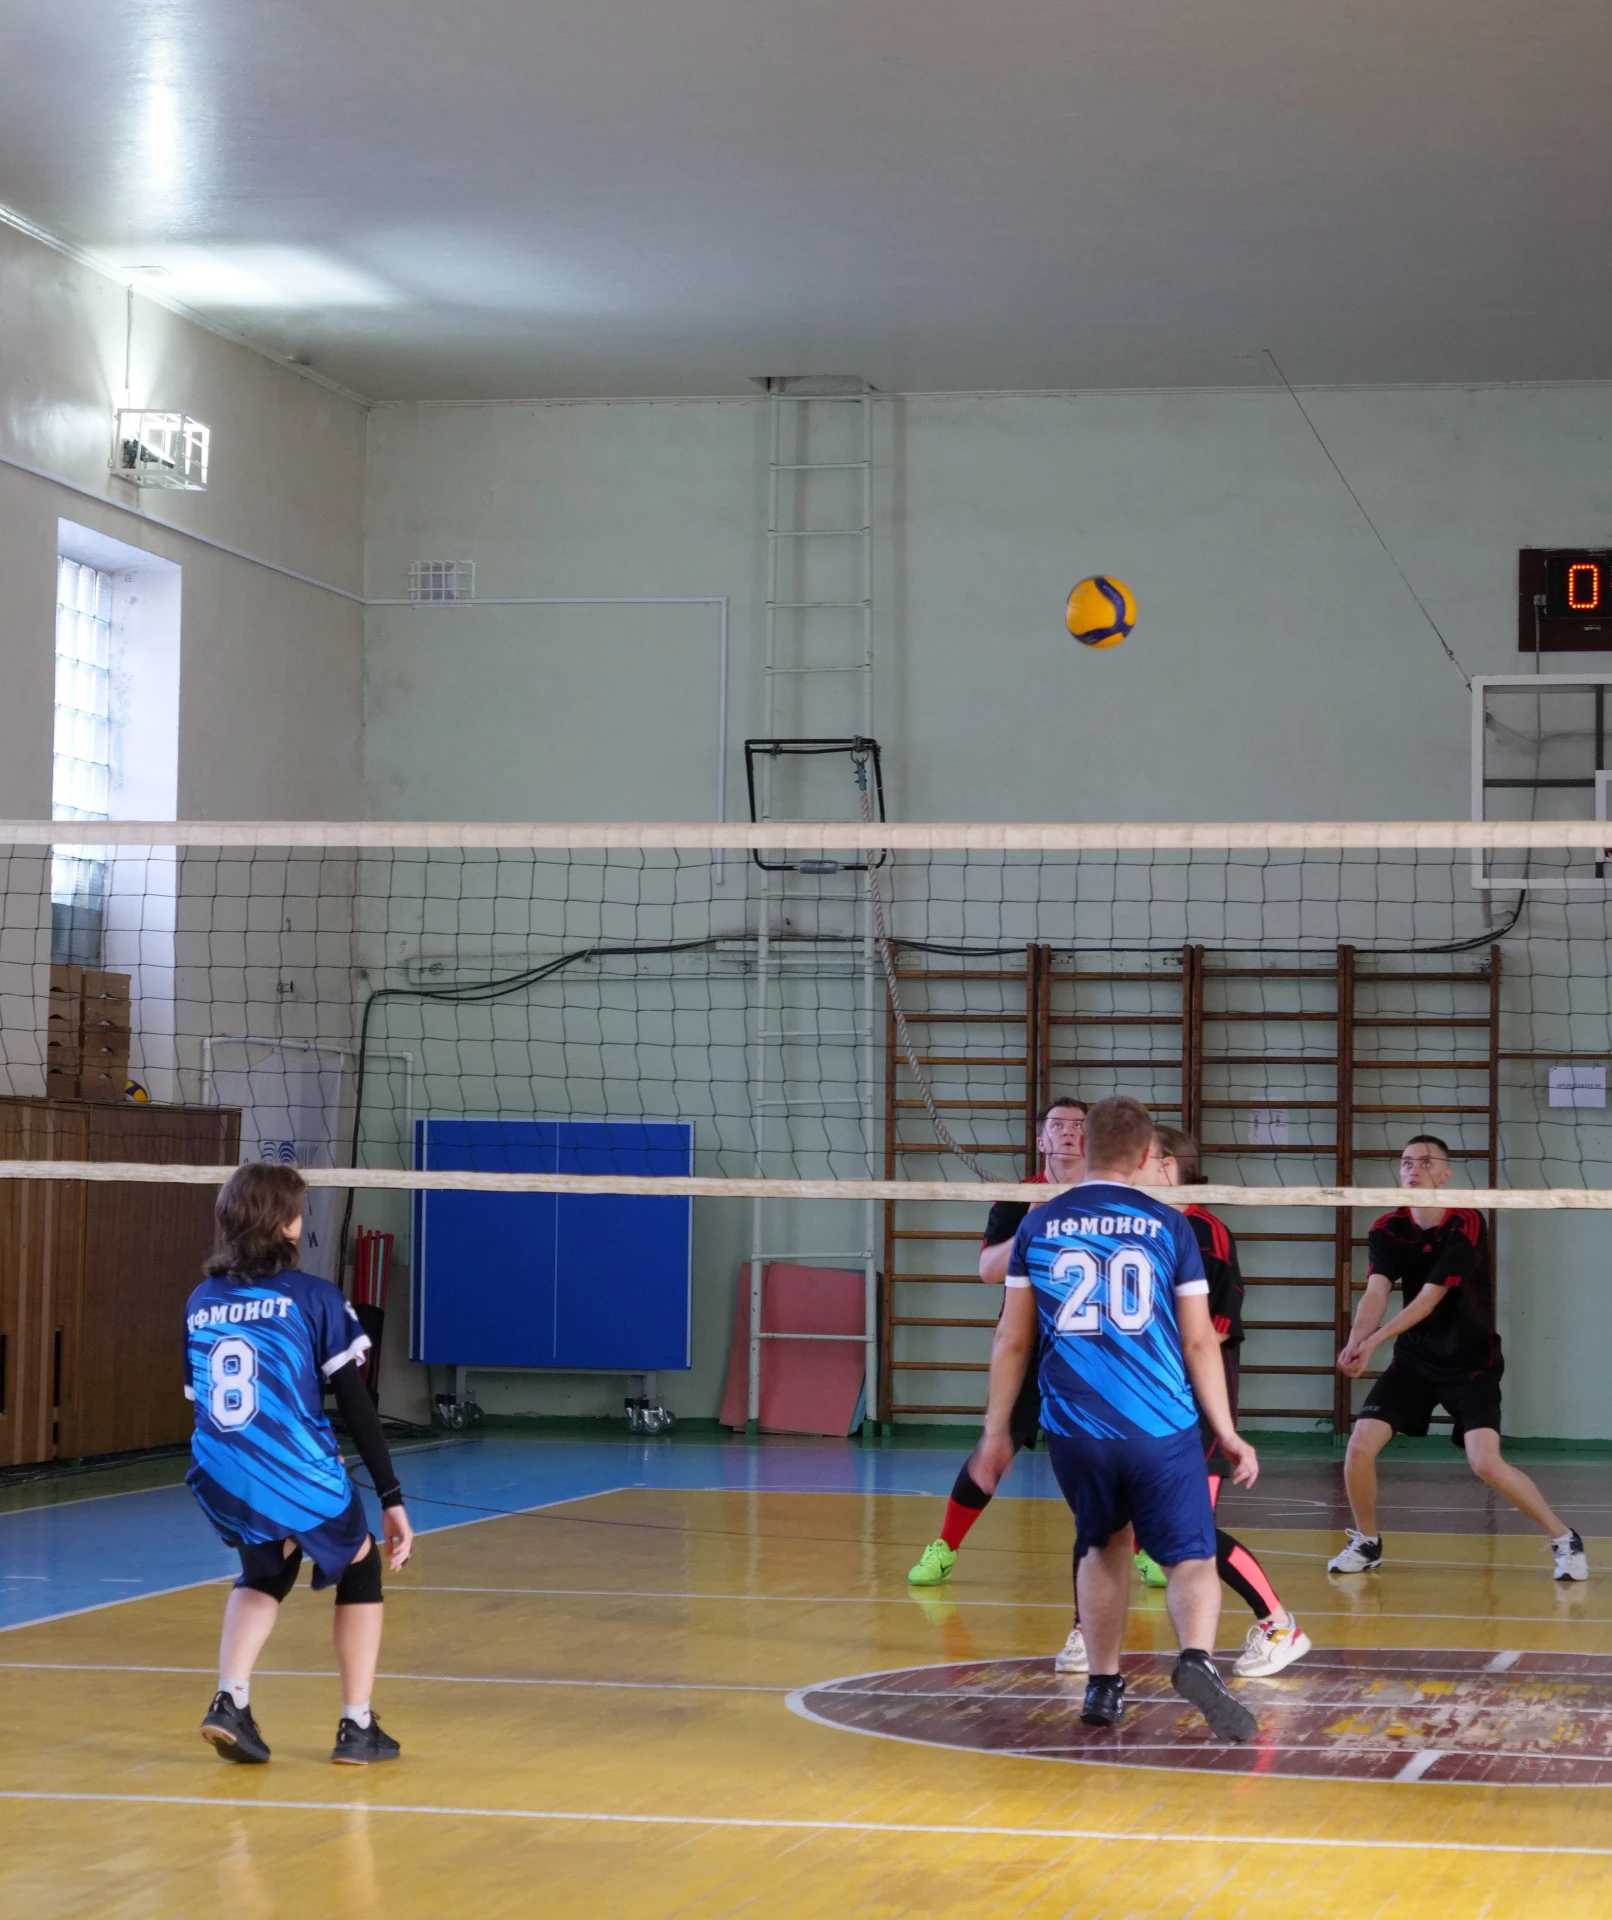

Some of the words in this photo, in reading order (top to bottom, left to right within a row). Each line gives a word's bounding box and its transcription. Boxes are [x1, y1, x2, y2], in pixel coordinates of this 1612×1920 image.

[1568, 563, 1599, 610] 0
[1051, 1245, 1155, 1336] 20
[207, 1335, 258, 1432] 8
